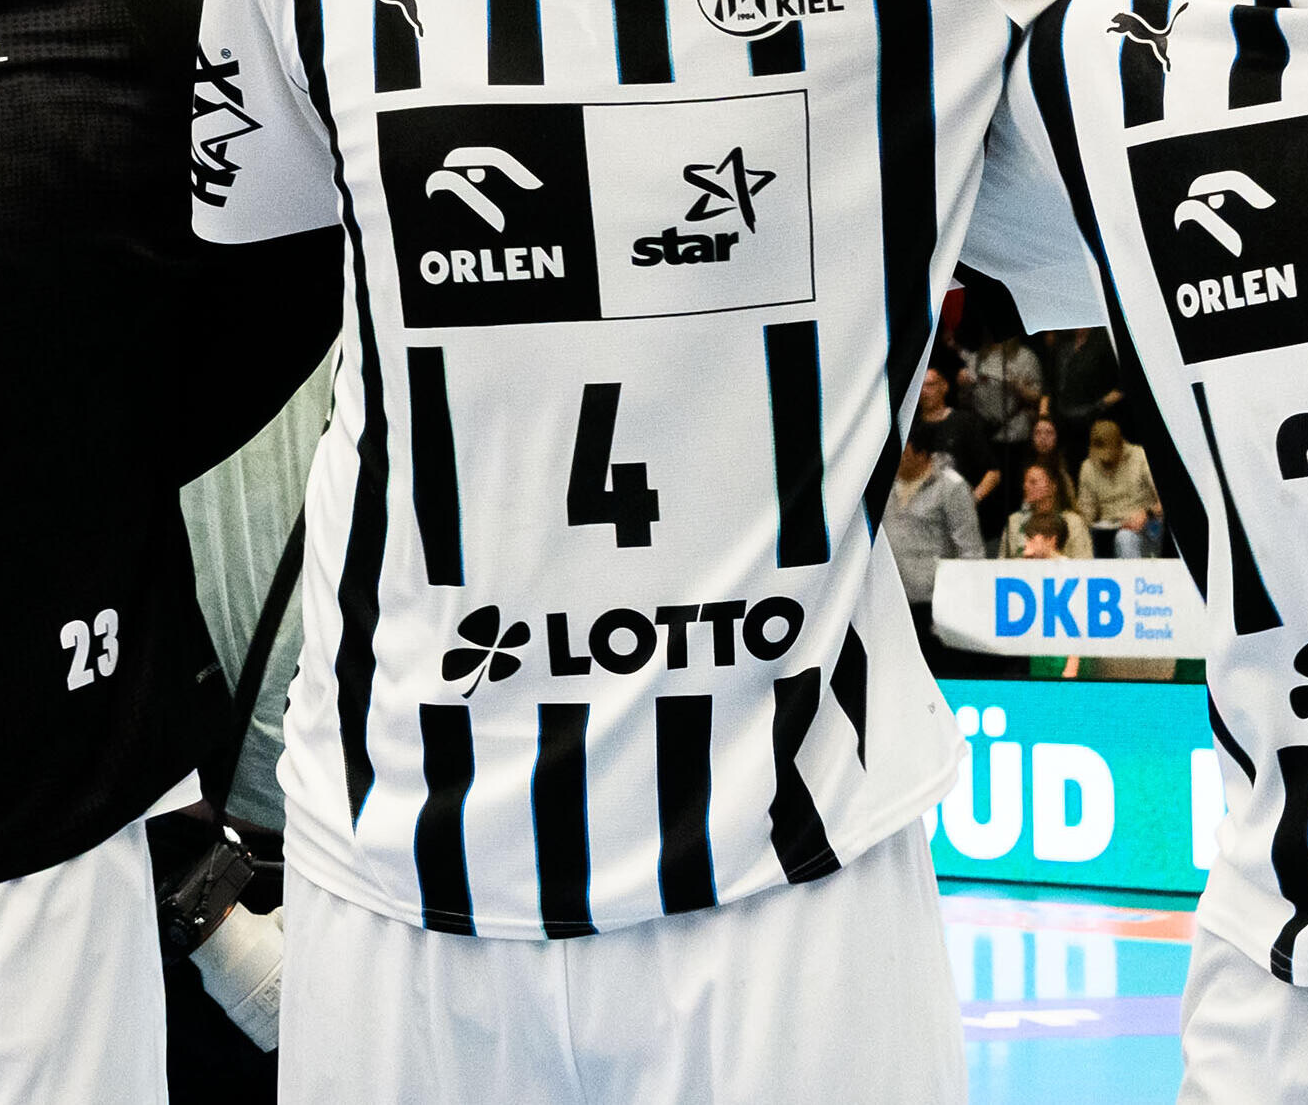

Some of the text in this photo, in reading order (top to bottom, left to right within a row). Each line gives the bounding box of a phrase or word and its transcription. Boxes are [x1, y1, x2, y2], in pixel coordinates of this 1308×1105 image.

[420, 246, 565, 285] ORLEN
[631, 226, 739, 267] star
[1175, 264, 1298, 319] ORLEN
[567, 383, 659, 548] 4
[995, 577, 1125, 638] DKB
[1134, 577, 1164, 596] Das
[59, 608, 120, 691] 23
[548, 595, 804, 677] LOTTO
[1134, 625, 1173, 640] Bank
[922, 705, 1115, 863] ÜD
